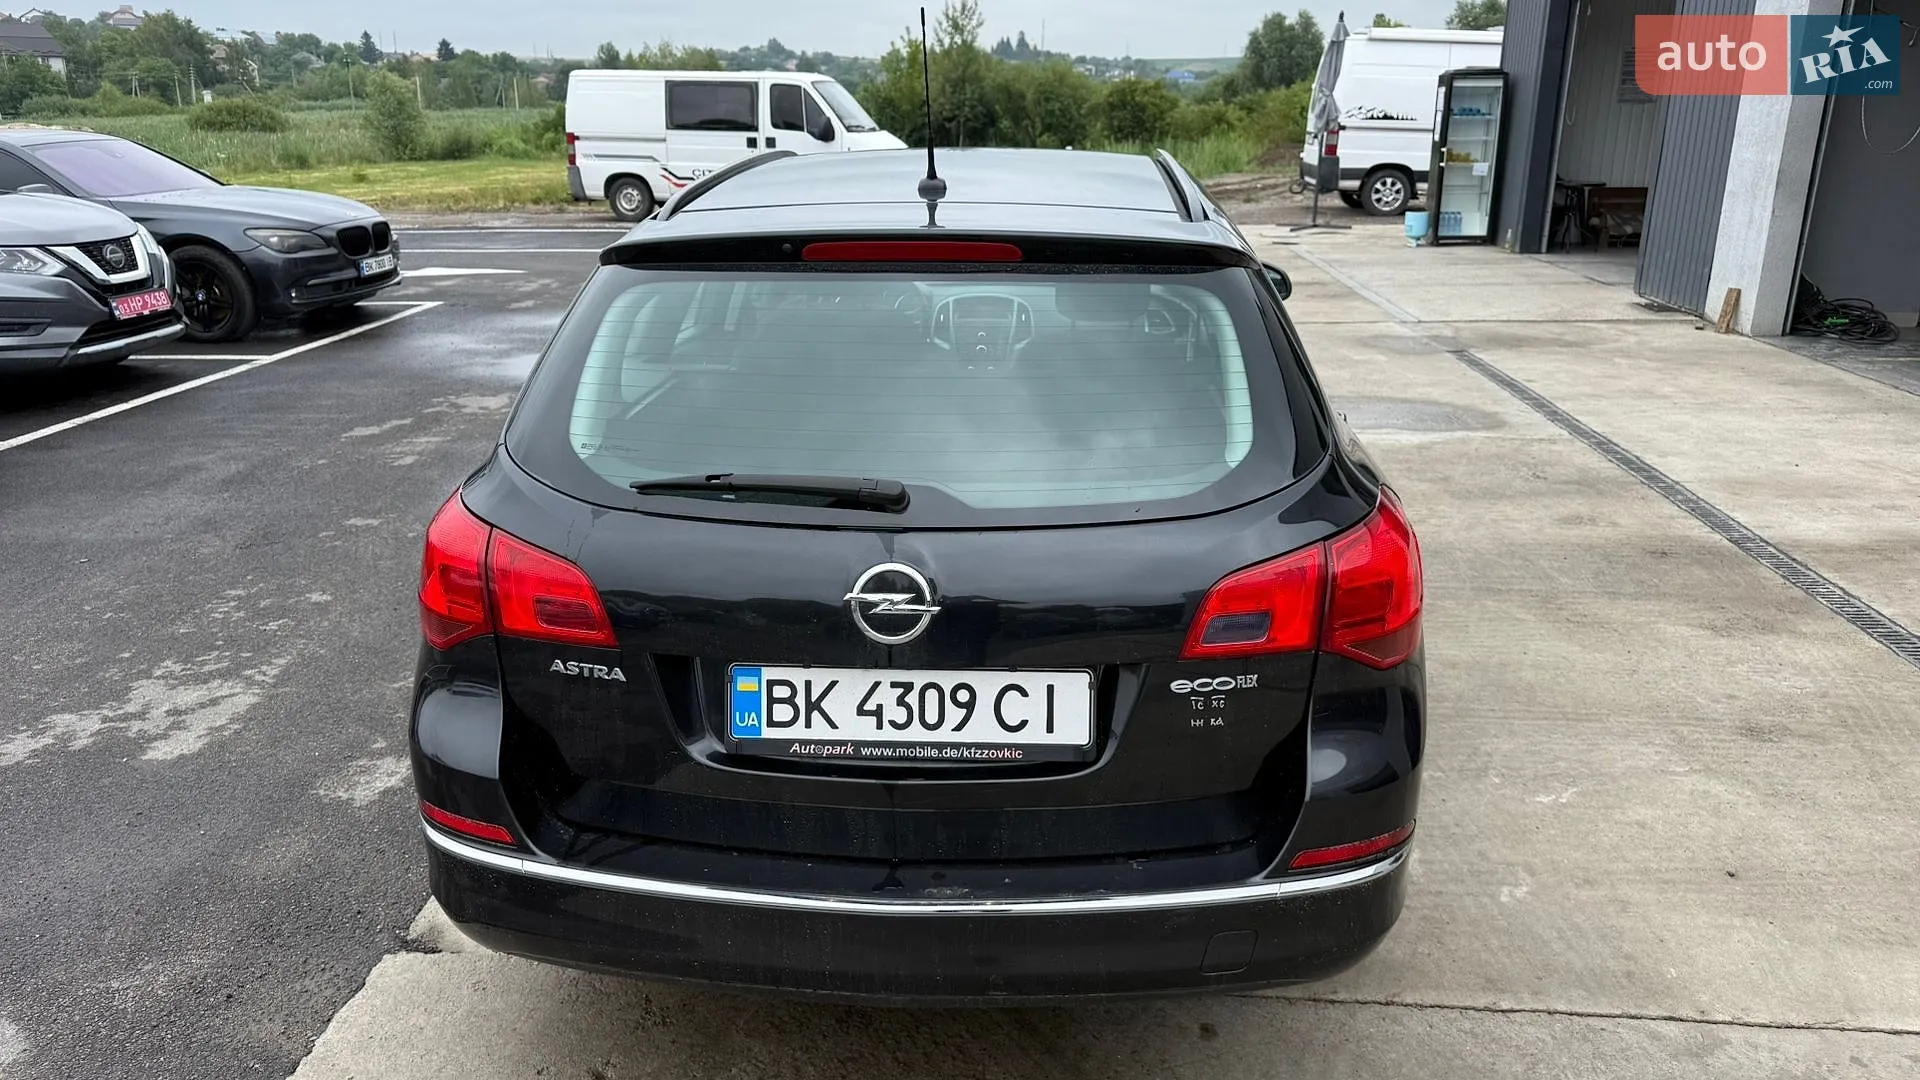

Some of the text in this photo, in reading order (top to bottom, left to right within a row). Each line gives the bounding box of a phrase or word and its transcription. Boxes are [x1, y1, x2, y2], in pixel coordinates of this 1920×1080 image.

[127, 296, 143, 312] HP
[144, 291, 167, 309] 9438
[549, 659, 627, 682] ASTRA
[765, 679, 1055, 734] BK 4309 CI
[735, 711, 759, 727] UA
